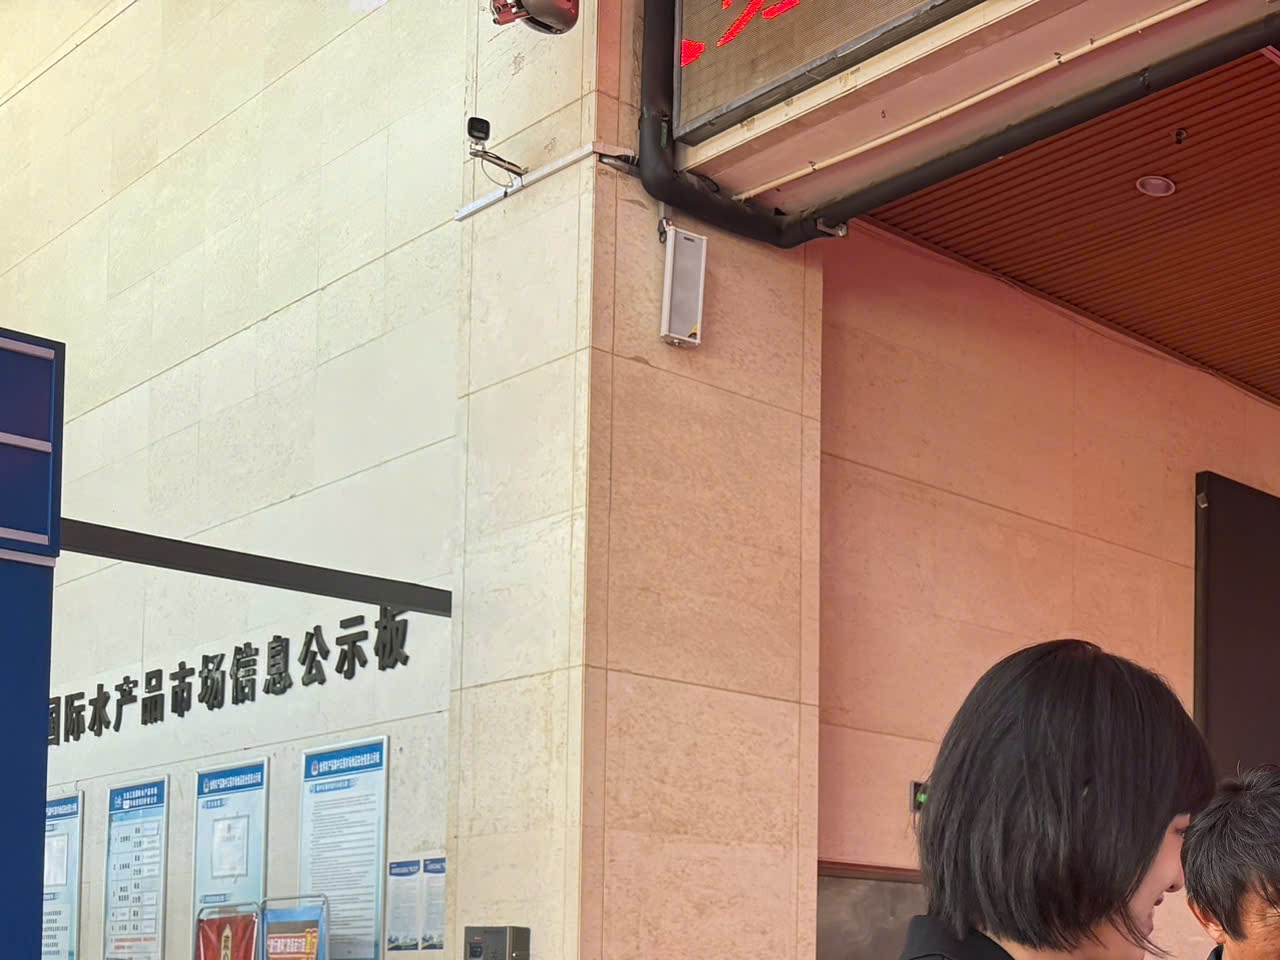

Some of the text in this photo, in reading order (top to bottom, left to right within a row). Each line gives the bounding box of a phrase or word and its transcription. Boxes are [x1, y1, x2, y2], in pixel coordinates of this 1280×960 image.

[48, 606, 409, 746] 国际水产品市场信息公示板
